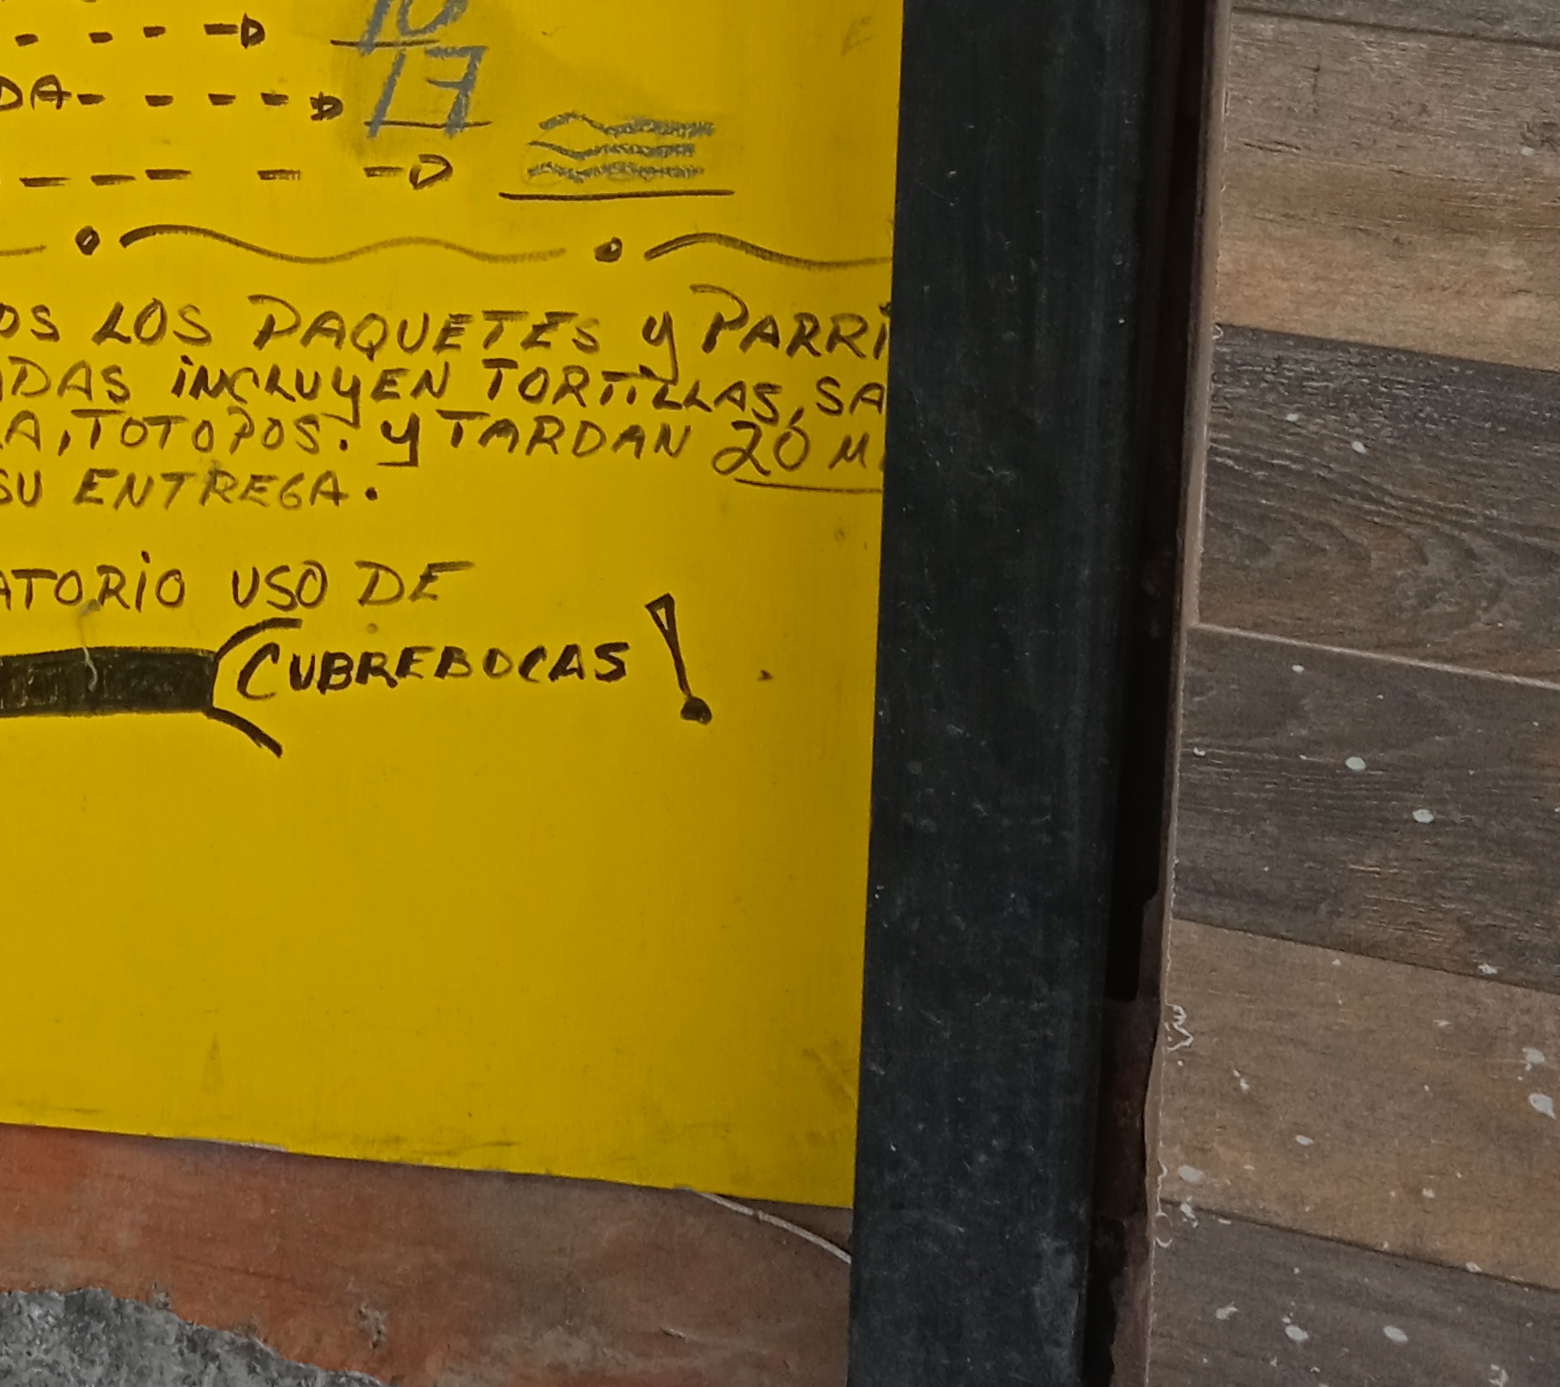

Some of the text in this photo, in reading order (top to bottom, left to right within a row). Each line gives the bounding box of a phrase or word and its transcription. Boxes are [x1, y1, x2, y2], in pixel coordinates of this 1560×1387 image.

[91, 298, 213, 346] LOS
[247, 293, 600, 362] PAQUETES
[171, 354, 450, 428] INCLUYEN
[436, 410, 692, 460] TARDAN
[710, 420, 812, 478] 20
[232, 559, 328, 613] USO
[354, 558, 476, 608] DE
